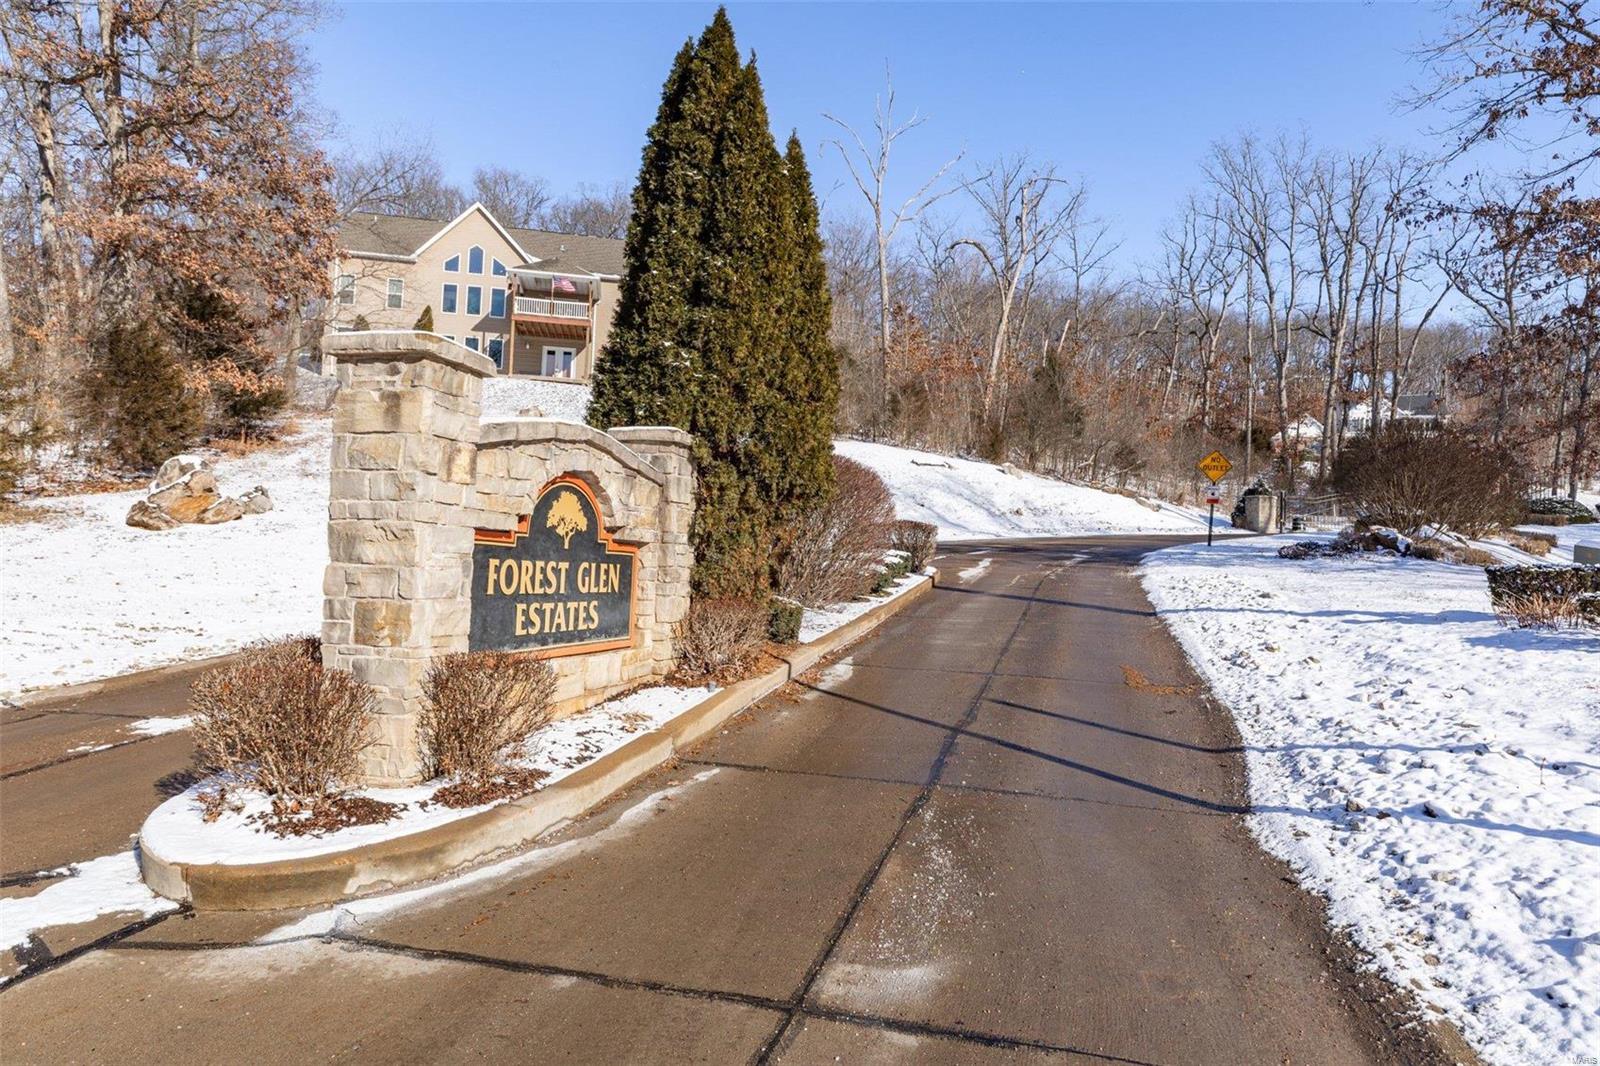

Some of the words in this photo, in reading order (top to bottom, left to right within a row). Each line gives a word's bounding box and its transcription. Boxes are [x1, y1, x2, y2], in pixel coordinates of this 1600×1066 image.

[486, 558, 569, 595] FOREST
[577, 562, 621, 593] GLEN
[515, 600, 599, 636] ESTATES
